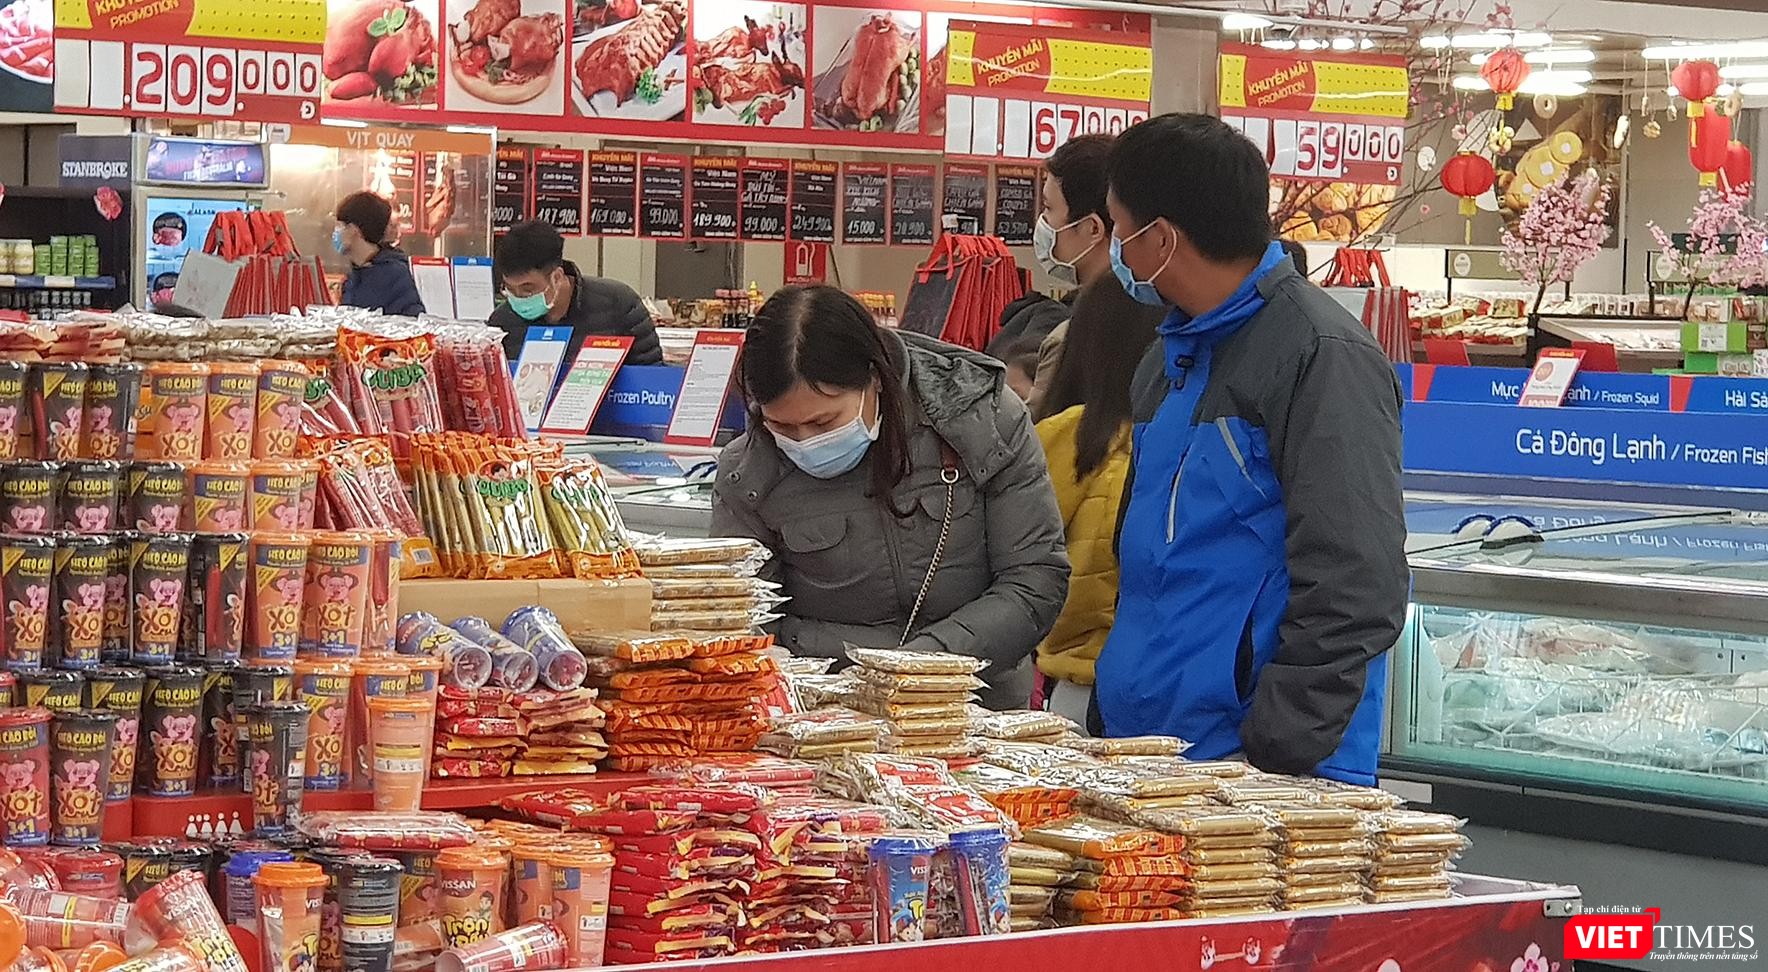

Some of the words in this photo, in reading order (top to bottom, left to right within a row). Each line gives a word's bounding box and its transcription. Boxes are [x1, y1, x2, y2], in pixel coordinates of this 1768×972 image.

[110, 0, 179, 29] PROMOTION
[1257, 80, 1306, 107] PROMOTION
[376, 132, 416, 148] QUAY
[62, 161, 129, 178] STANBROKE
[608, 391, 640, 405] Frozen
[641, 390, 676, 409] Poultry
[1601, 391, 1634, 404] Frozen
[1635, 392, 1660, 406] Squid
[1515, 428, 1545, 455] Cá
[1550, 429, 1605, 465] Đông
[1612, 432, 1666, 464] Lạnh
[1684, 445, 1738, 464] Frozen
